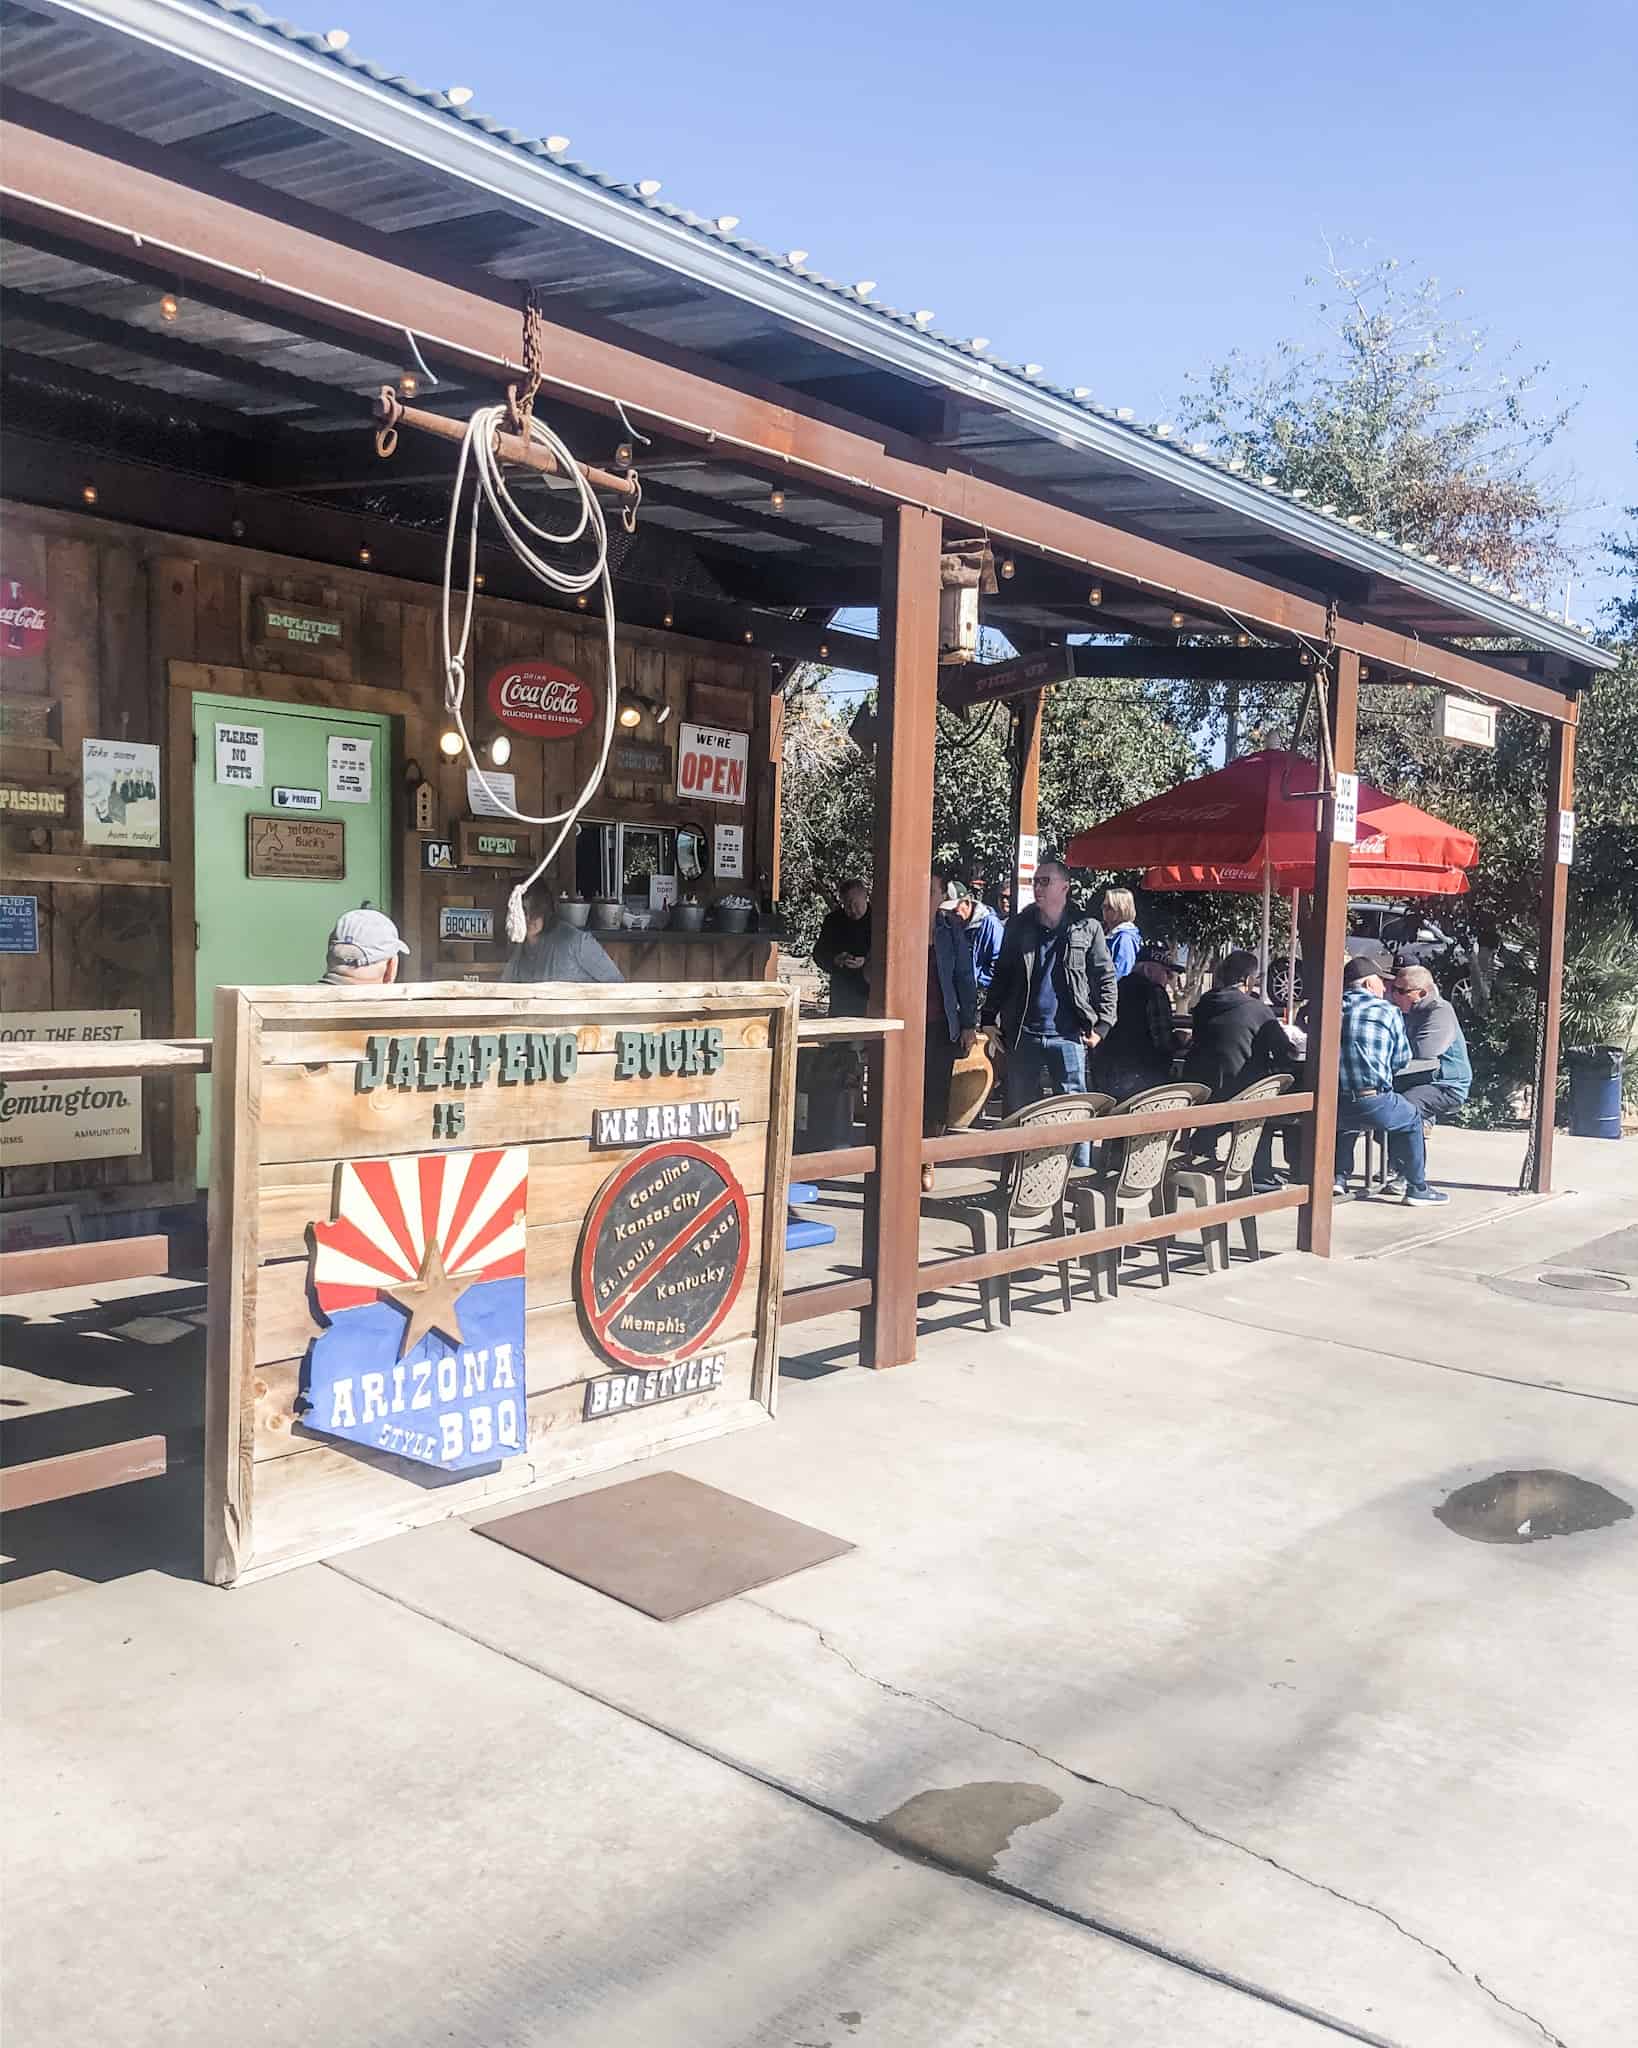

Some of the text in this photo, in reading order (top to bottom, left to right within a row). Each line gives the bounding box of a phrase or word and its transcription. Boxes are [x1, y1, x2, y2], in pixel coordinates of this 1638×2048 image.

[287, 628, 320, 644] ONLY
[502, 709, 533, 720] DELICIOUS
[220, 729, 258, 746] PLEASE
[697, 733, 732, 749] WE'RE
[232, 748, 246, 762] NO
[226, 765, 252, 780] PETS
[682, 752, 744, 796] OPEN
[0, 790, 65, 813] PASSING
[292, 794, 317, 805] PRIVATE
[428, 843, 453, 868] CA
[478, 836, 516, 854] OPEN
[46, 1027, 76, 1042] THE
[82, 1025, 123, 1042] BEST
[359, 1028, 724, 1091] JALAPENO BUCKS
[75, 1127, 130, 1138] AMMUNITION
[434, 1102, 465, 1137] IS
[600, 1101, 740, 1143] WE ARE NOT
[629, 1158, 690, 1208] Carolina
[615, 1190, 702, 1242] Kansas City
[692, 1214, 735, 1258] Texas
[599, 1237, 656, 1299] St. Louis
[656, 1264, 725, 1300] Kentucky
[620, 1314, 686, 1335] Memphis
[331, 1343, 516, 1428] ARIZONA
[591, 1352, 727, 1415] BBQ STYLES
[378, 1422, 439, 1461] STYLE
[439, 1399, 521, 1461] BBQ
